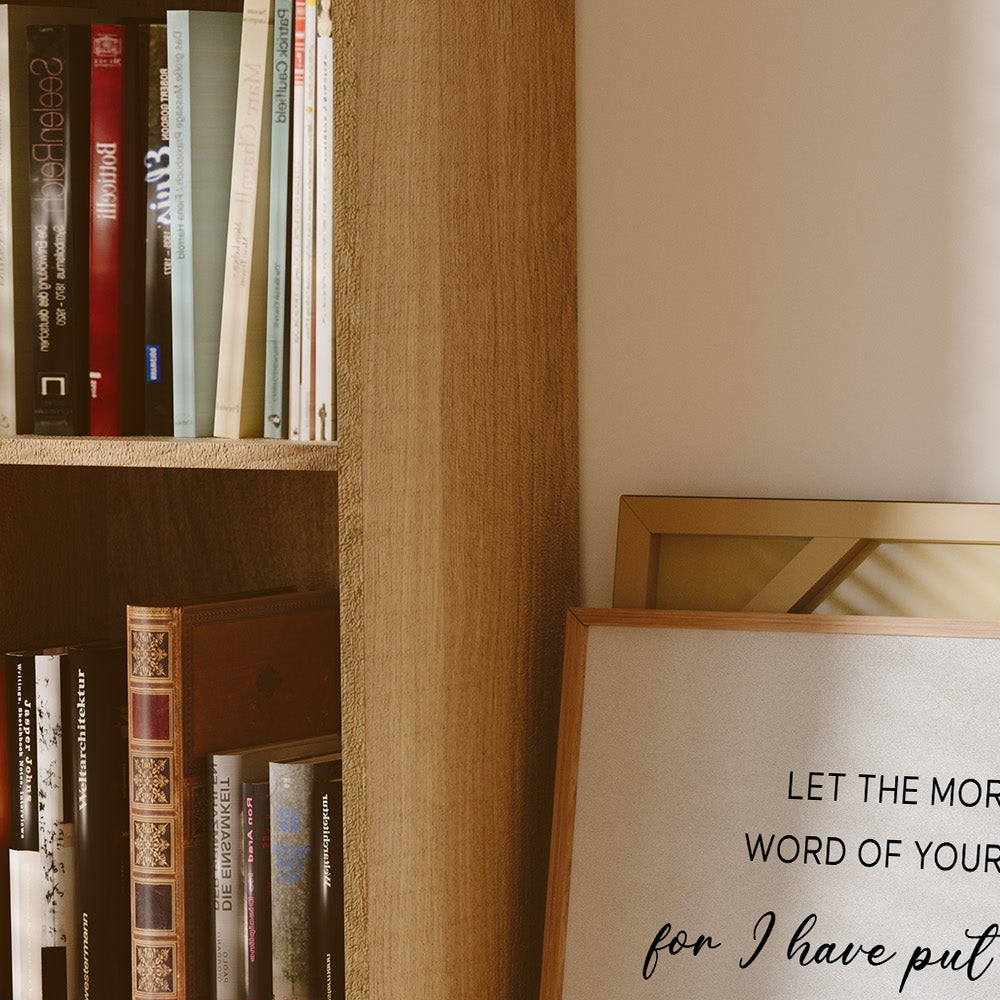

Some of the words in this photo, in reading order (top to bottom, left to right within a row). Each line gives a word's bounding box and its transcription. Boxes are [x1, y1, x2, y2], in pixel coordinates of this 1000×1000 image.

[24, 699, 32, 752] Jasper
[77, 668, 88, 812] Weltarchitektur
[25, 756, 34, 802] Johns
[788, 771, 846, 801] LET
[859, 774, 918, 804] THE
[745, 833, 845, 865] WORD
[859, 839, 901, 867] OF
[643, 923, 721, 980] for
[739, 911, 775, 969] I
[787, 914, 896, 966] have
